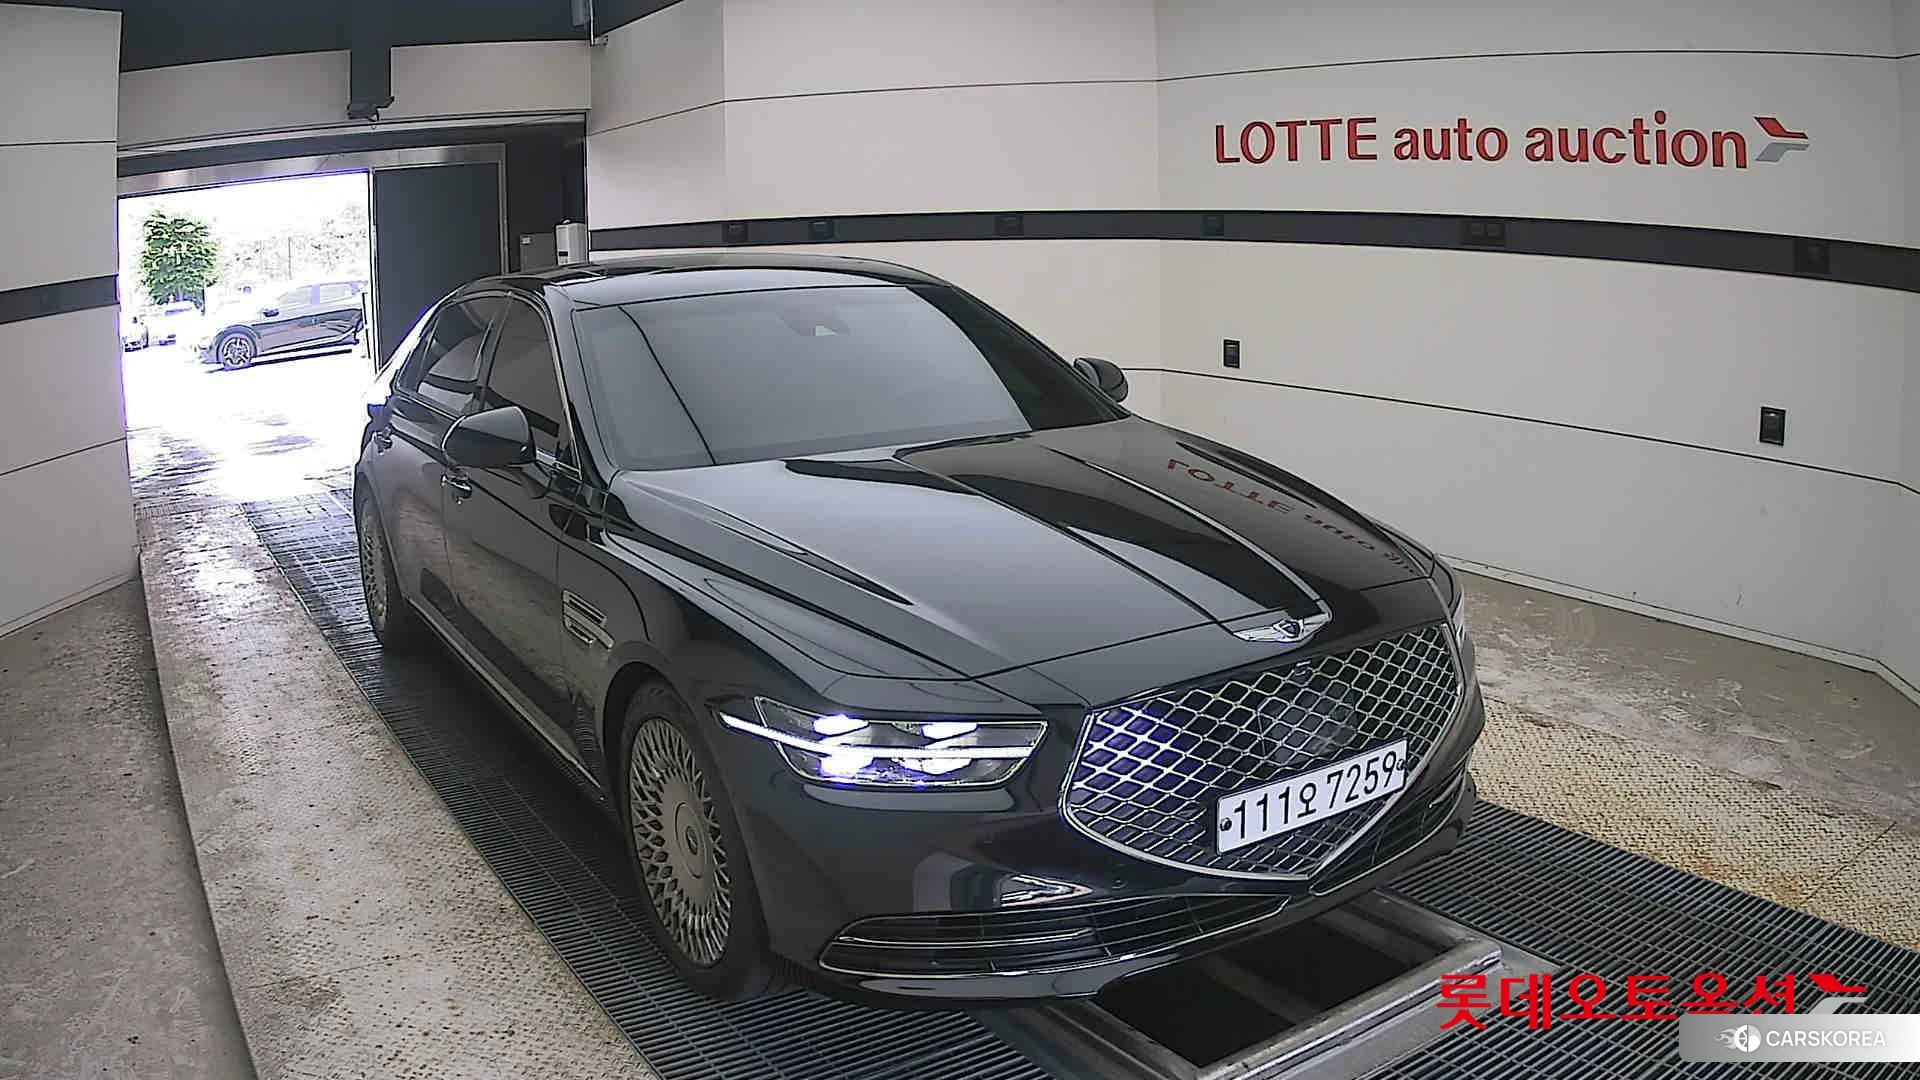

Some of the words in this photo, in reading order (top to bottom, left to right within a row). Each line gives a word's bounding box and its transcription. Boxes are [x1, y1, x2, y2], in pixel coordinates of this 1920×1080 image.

[1215, 117, 1377, 164] LOTTE
[1393, 117, 1509, 163] auto
[1524, 110, 1748, 169] auction
[1234, 783, 1317, 840] 111오
[1326, 751, 1397, 809] 7259
